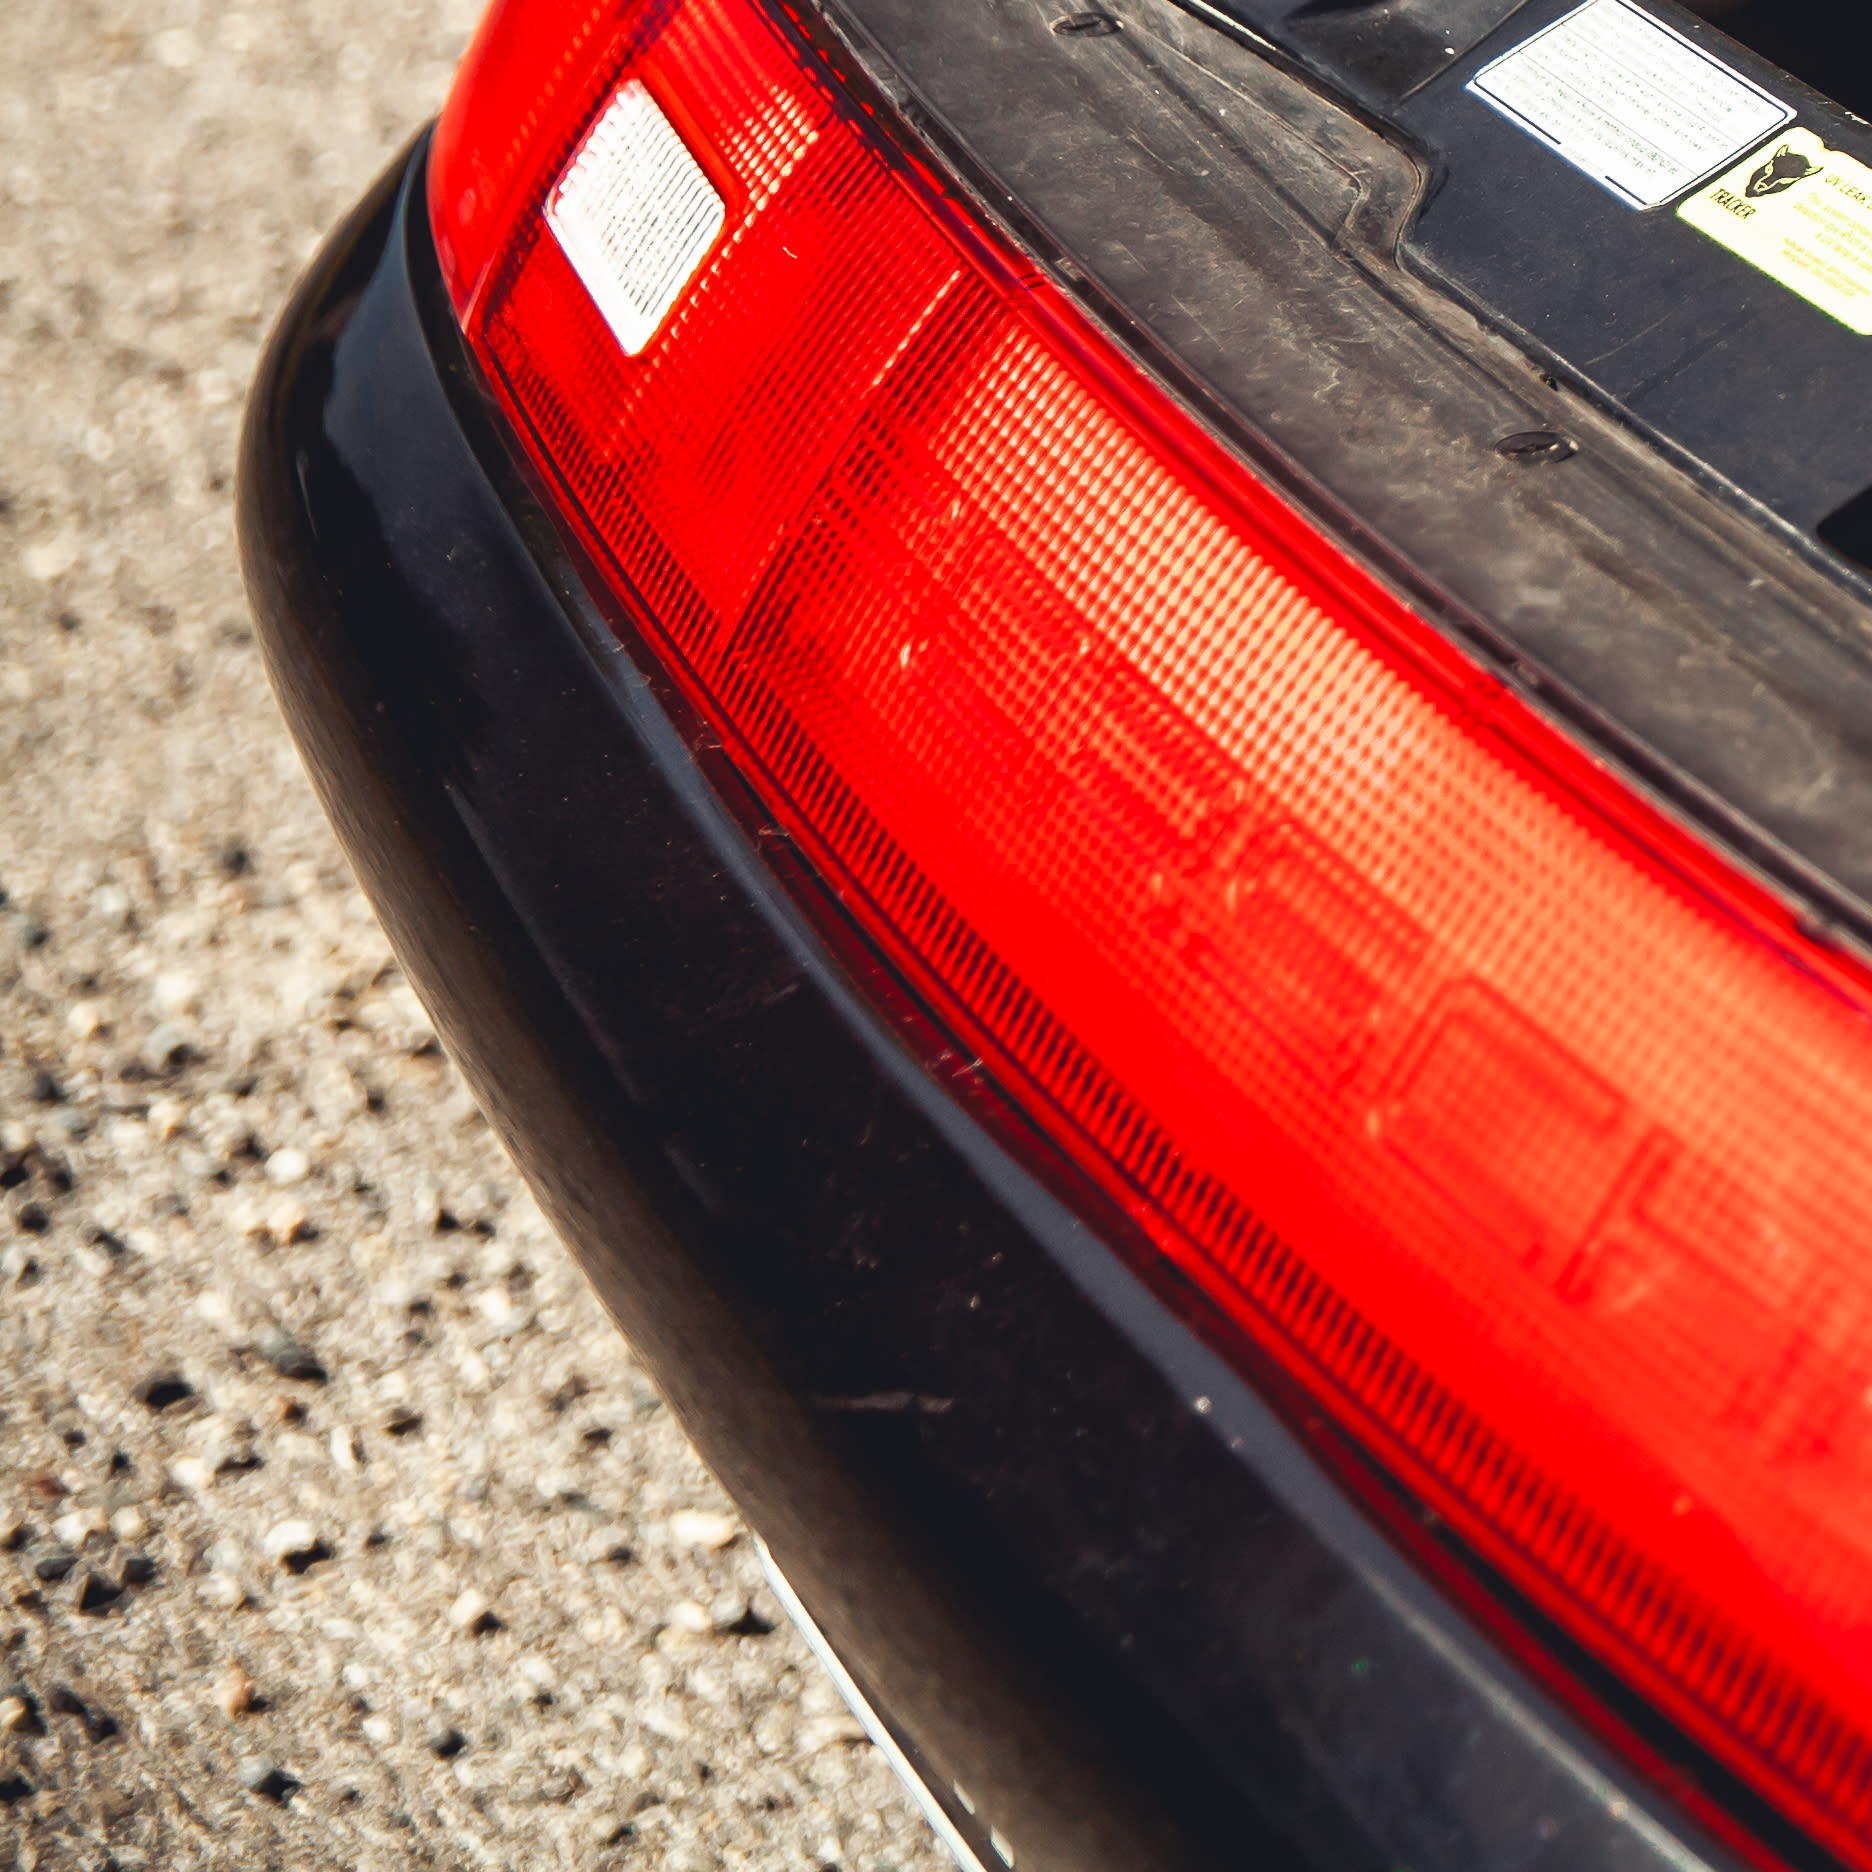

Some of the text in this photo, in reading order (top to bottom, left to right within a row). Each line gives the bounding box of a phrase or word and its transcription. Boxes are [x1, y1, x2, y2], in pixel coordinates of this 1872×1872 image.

[1709, 188, 1757, 220] TRACKER
[1824, 172, 1845, 188] UV
[1839, 183, 1872, 205] LEAK
